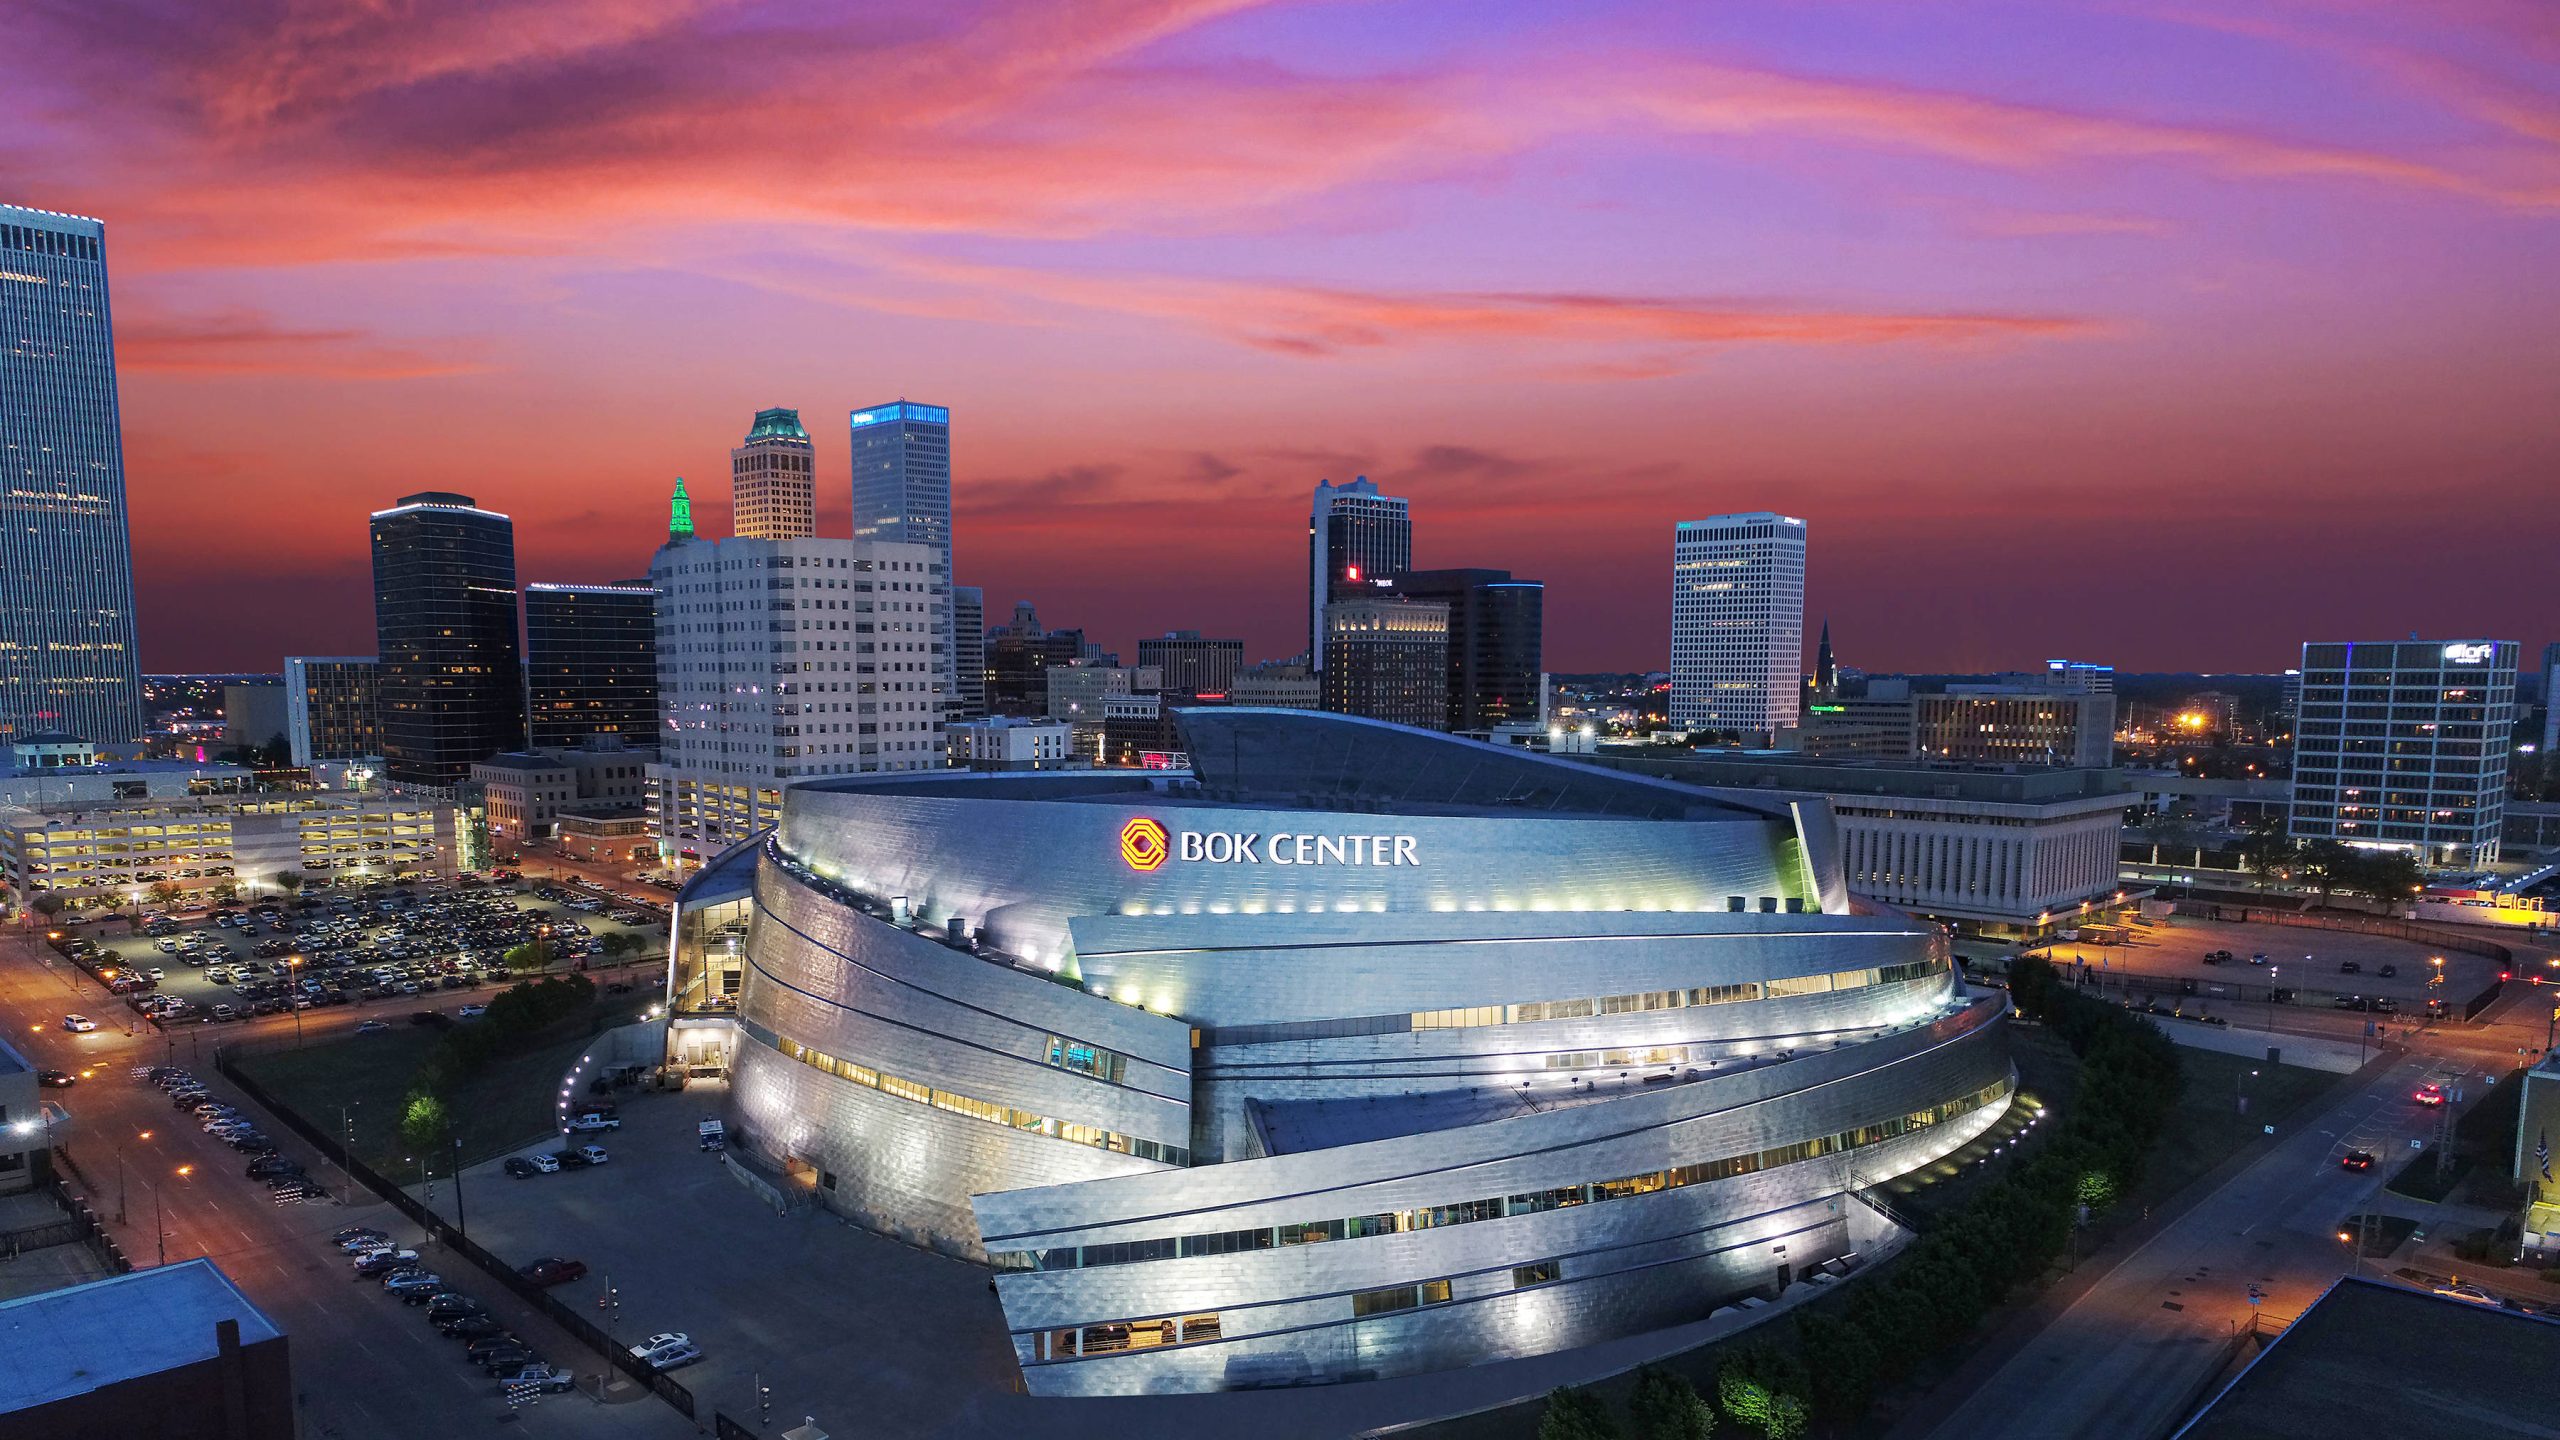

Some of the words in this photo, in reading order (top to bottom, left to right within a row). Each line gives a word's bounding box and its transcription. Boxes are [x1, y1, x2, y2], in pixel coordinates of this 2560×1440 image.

[1181, 831, 1260, 863] BOK
[1268, 833, 1421, 866] CENTER
[2495, 891, 2545, 912] aloft
